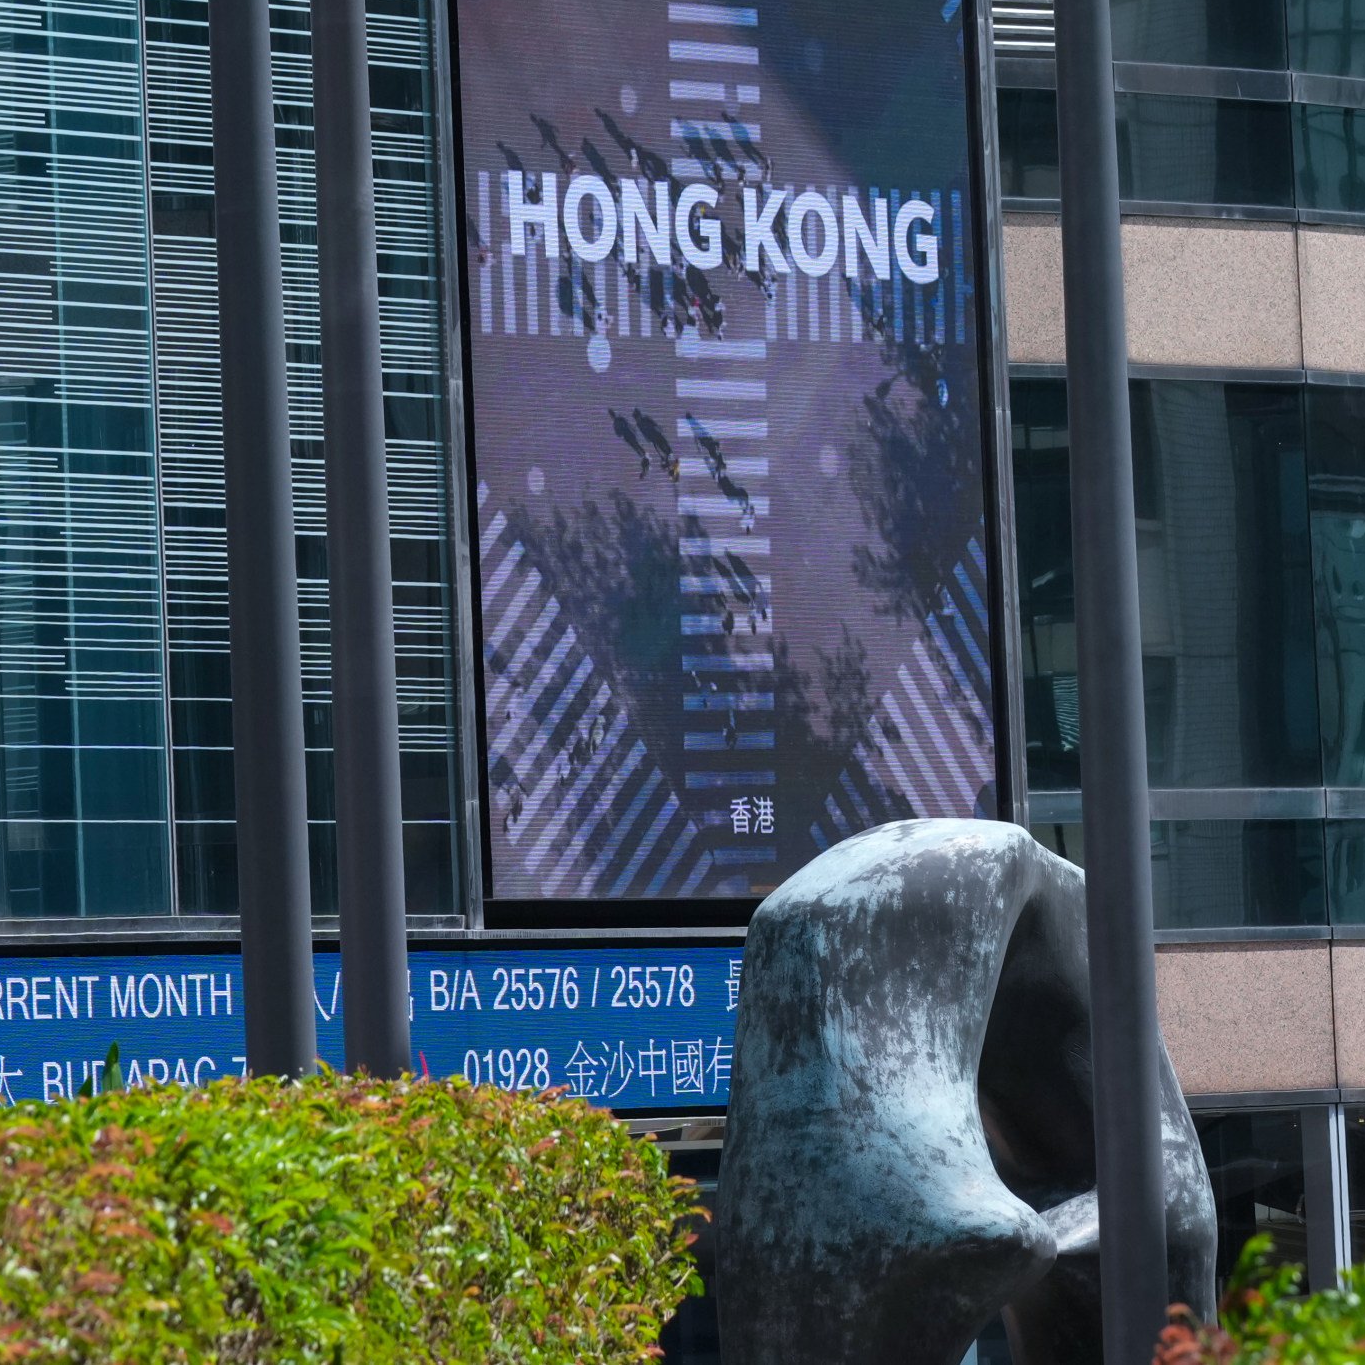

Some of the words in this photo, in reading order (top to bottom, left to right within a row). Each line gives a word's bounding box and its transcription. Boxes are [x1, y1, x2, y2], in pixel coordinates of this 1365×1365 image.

[507, 169, 723, 272] HONG
[744, 186, 939, 284] KONG
[730, 796, 775, 834] 香港
[110, 973, 232, 1019] MONTH
[430, 969, 482, 1012] B/A
[492, 966, 580, 1011] 25576
[591, 967, 600, 1008] /
[610, 964, 695, 1008] 25578
[126, 1056, 216, 1094] APAC
[463, 1047, 551, 1092] 01928
[564, 1036, 734, 1099] 金沙中國有
